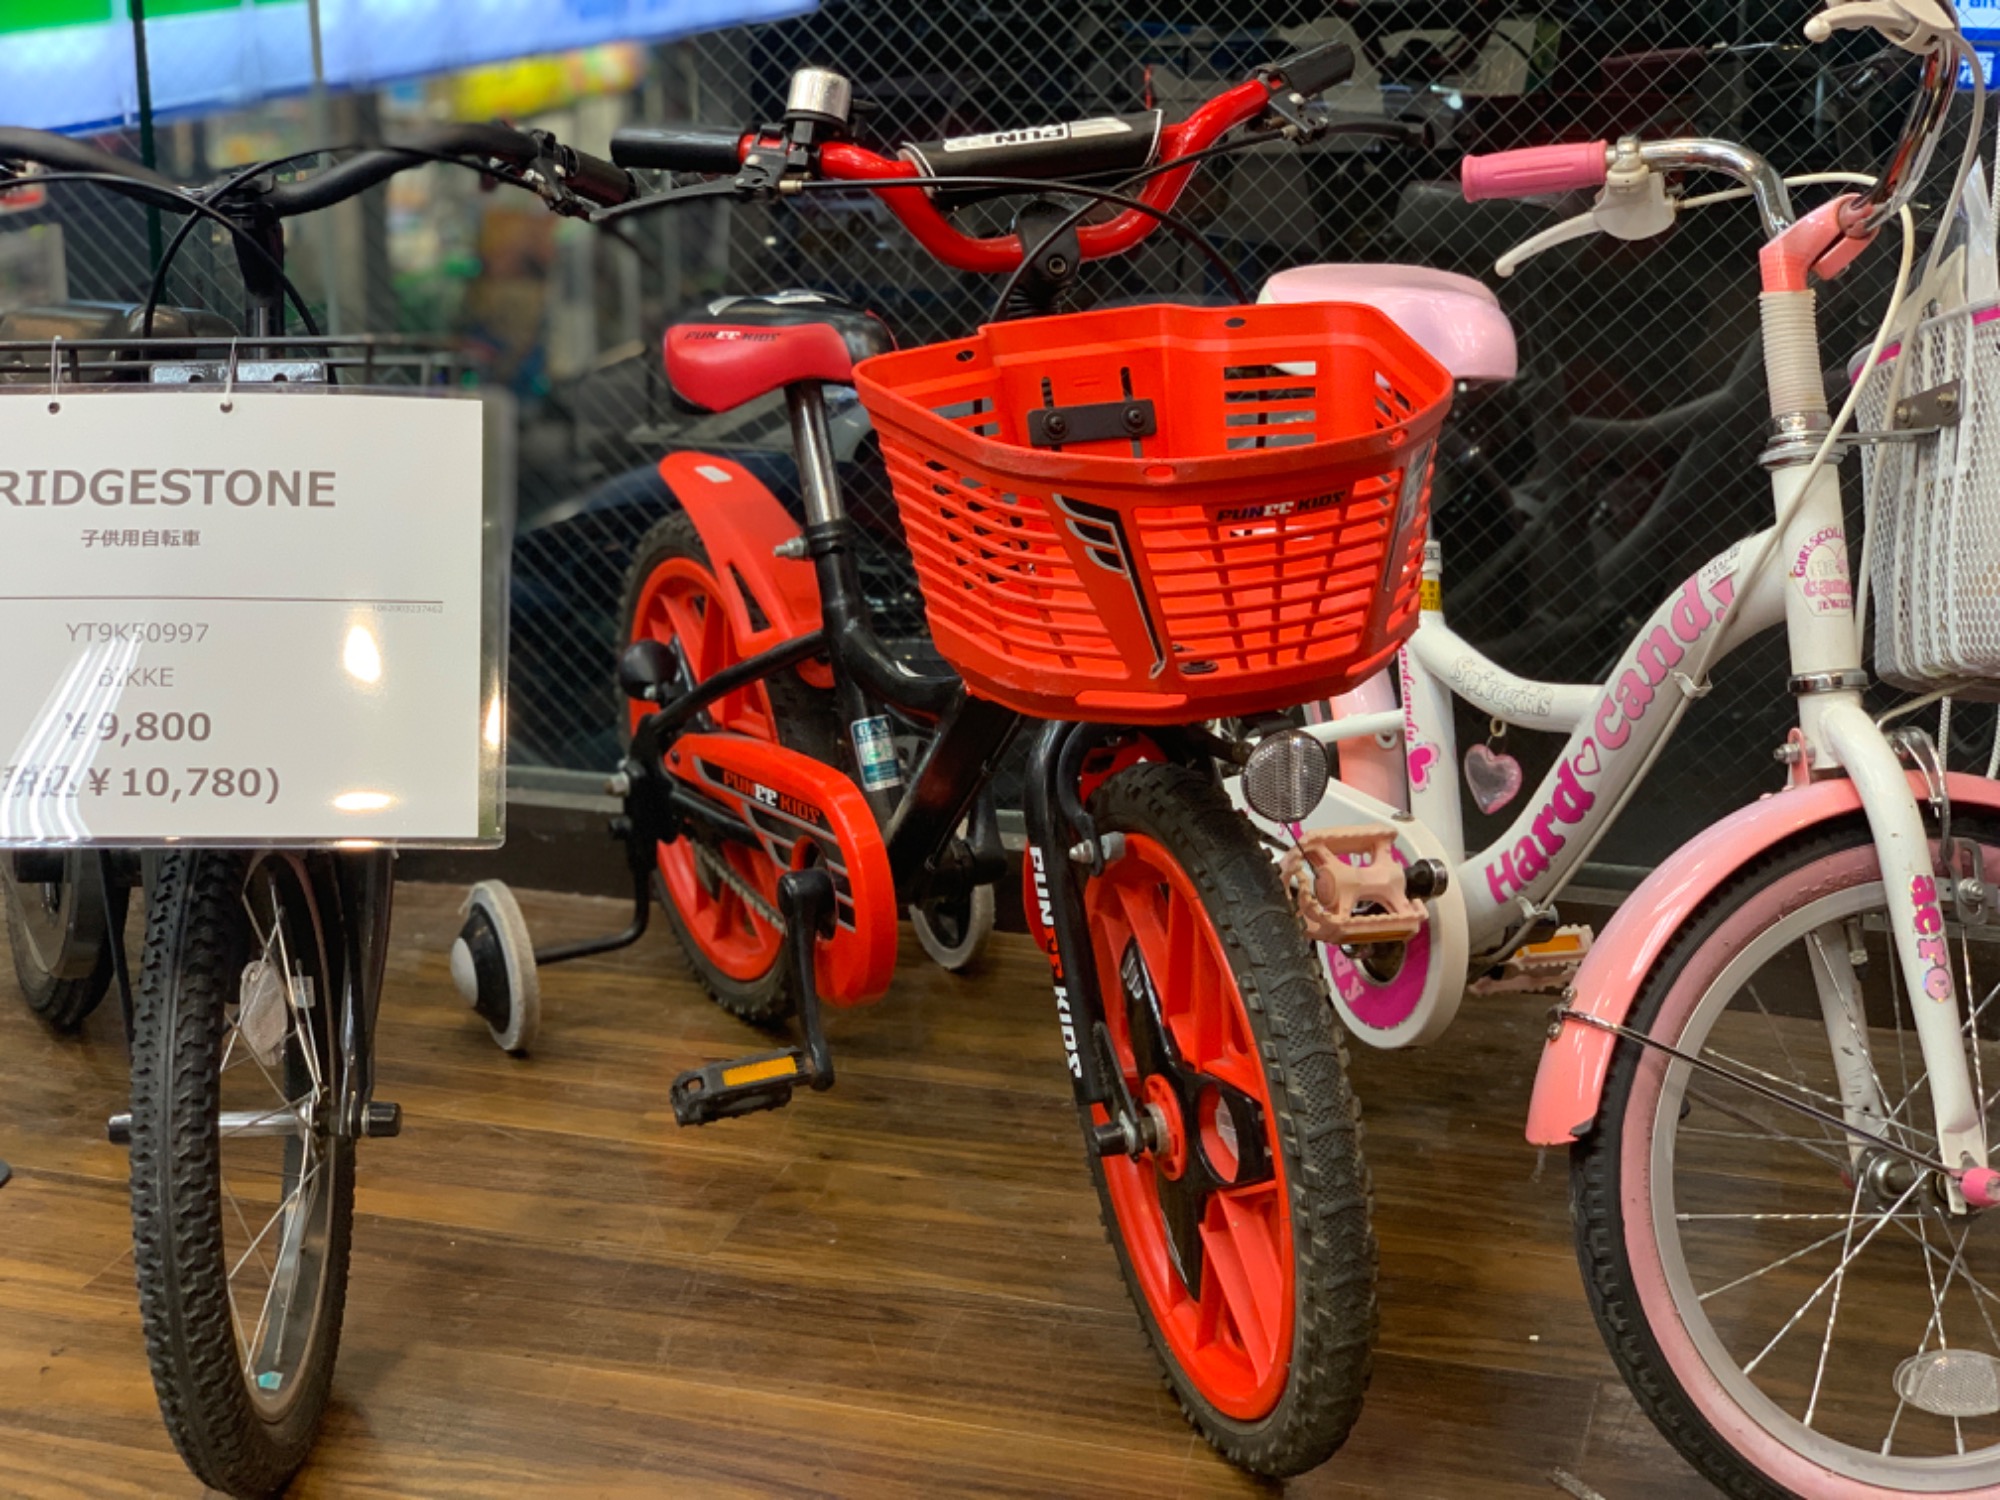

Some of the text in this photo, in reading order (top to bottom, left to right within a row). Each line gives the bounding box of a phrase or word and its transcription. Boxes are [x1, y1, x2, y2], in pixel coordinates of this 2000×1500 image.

[0, 469, 337, 508] RIDGESTONE
[1216, 490, 1346, 522] PUNEE KIDS
[80, 529, 201, 548] 子供用自転車
[66, 622, 210, 643] YT9K50997
[723, 769, 821, 824] PUNEE KIDS
[1484, 757, 1596, 905] Hard
[1053, 985, 1083, 1079] KIDS
